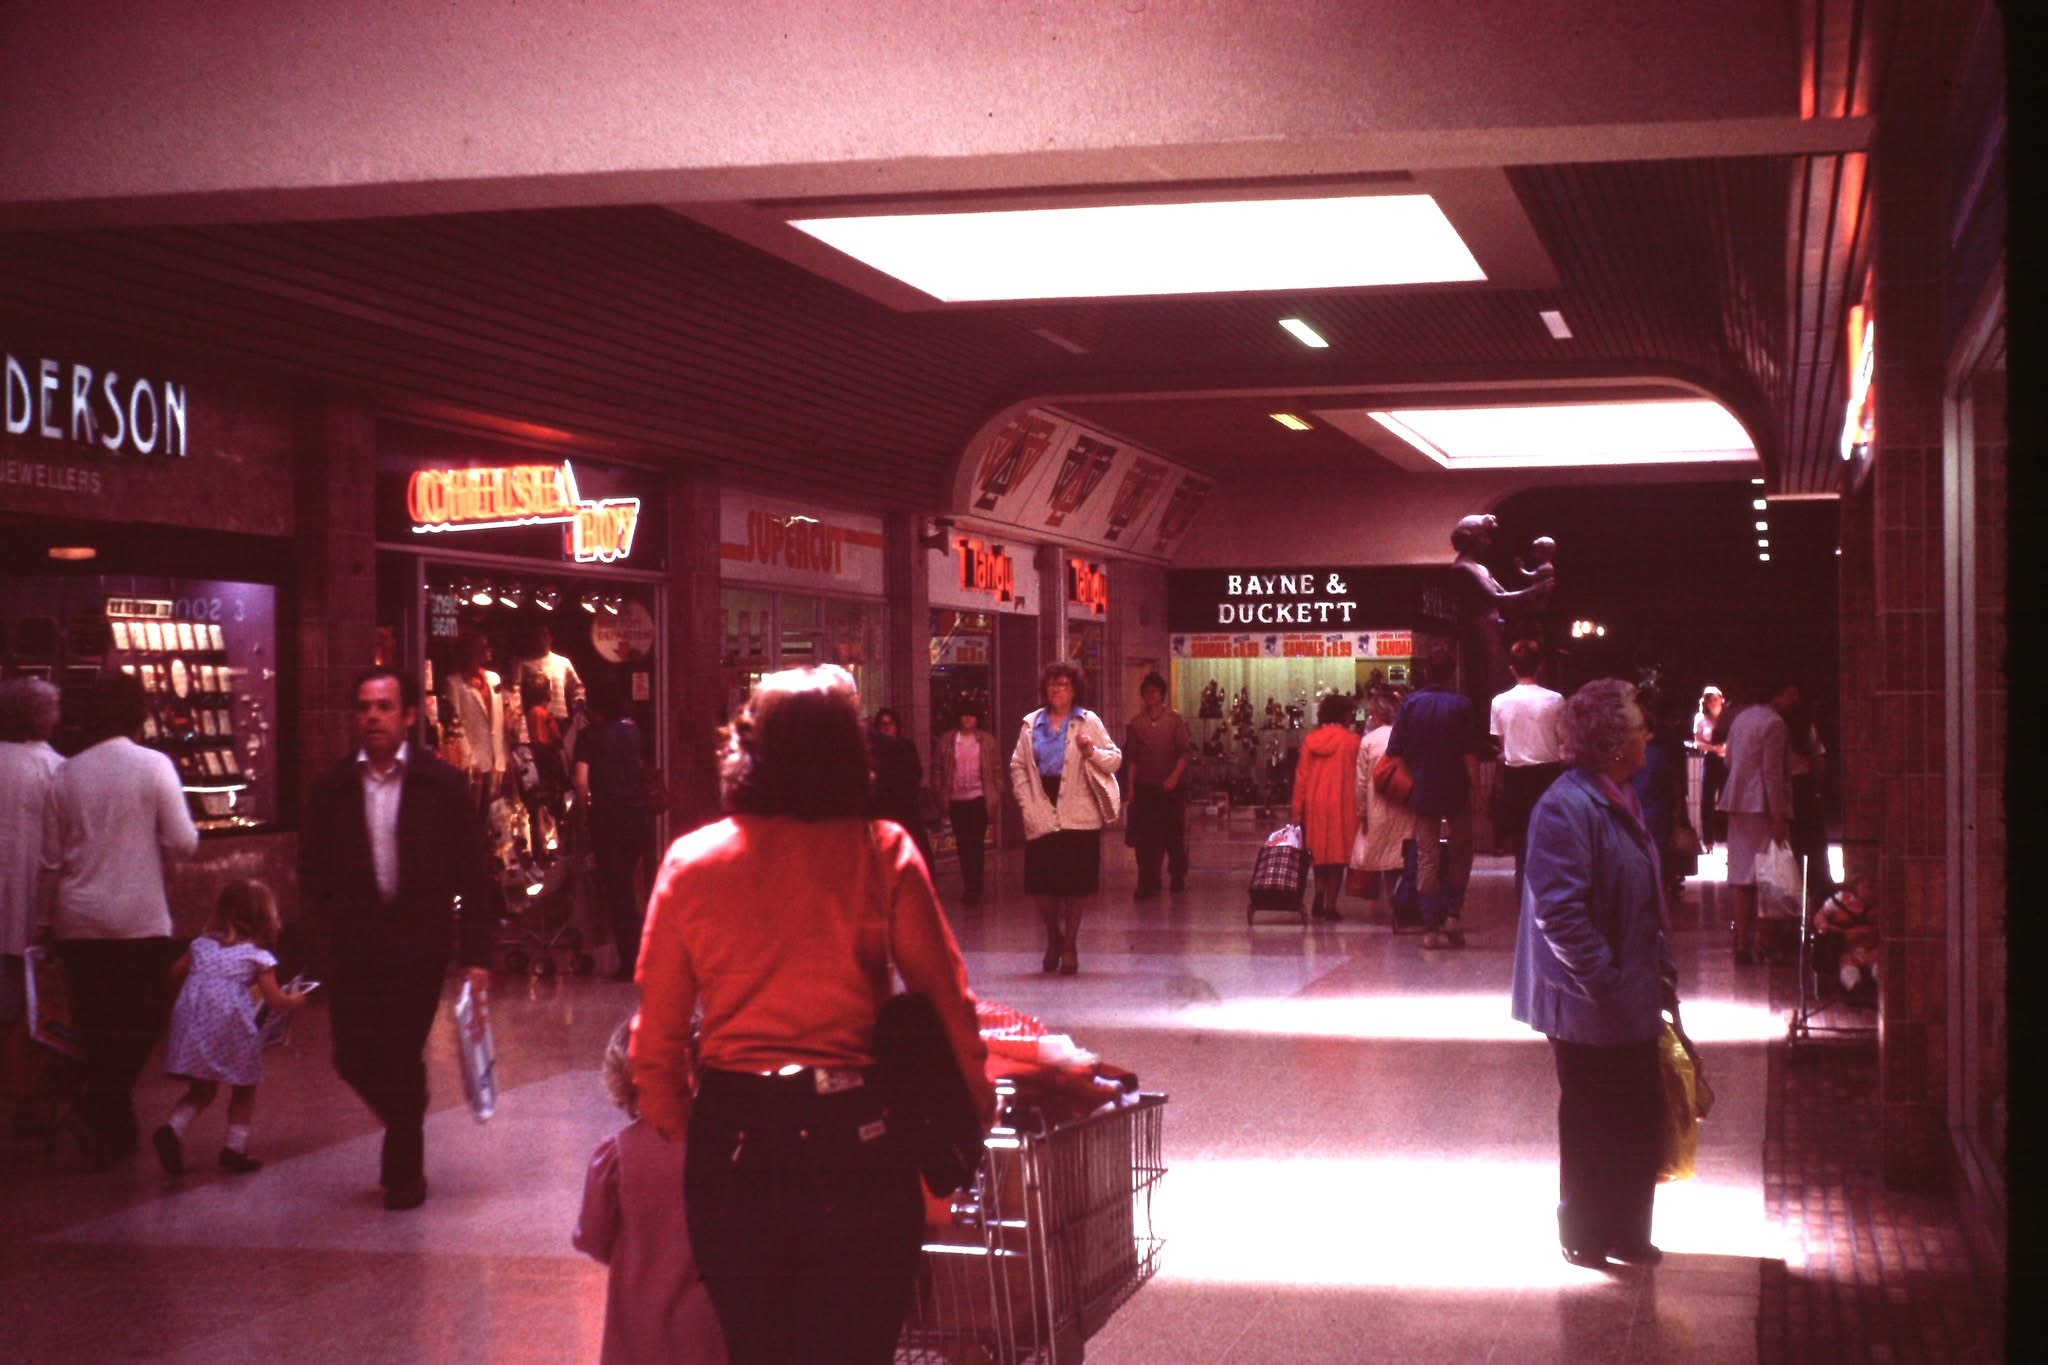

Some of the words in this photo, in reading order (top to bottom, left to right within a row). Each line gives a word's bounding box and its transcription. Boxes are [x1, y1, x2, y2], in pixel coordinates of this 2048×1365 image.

[5, 353, 188, 457] DERSON
[747, 510, 844, 575] SUPERCUT
[952, 536, 1014, 602] Tandy
[1067, 558, 1108, 614] Tandy
[1228, 574, 1315, 596] BAYNE
[1326, 573, 1348, 595] &
[1218, 602, 1357, 624] DUCKETT
[1284, 641, 1324, 657] SANDALS
